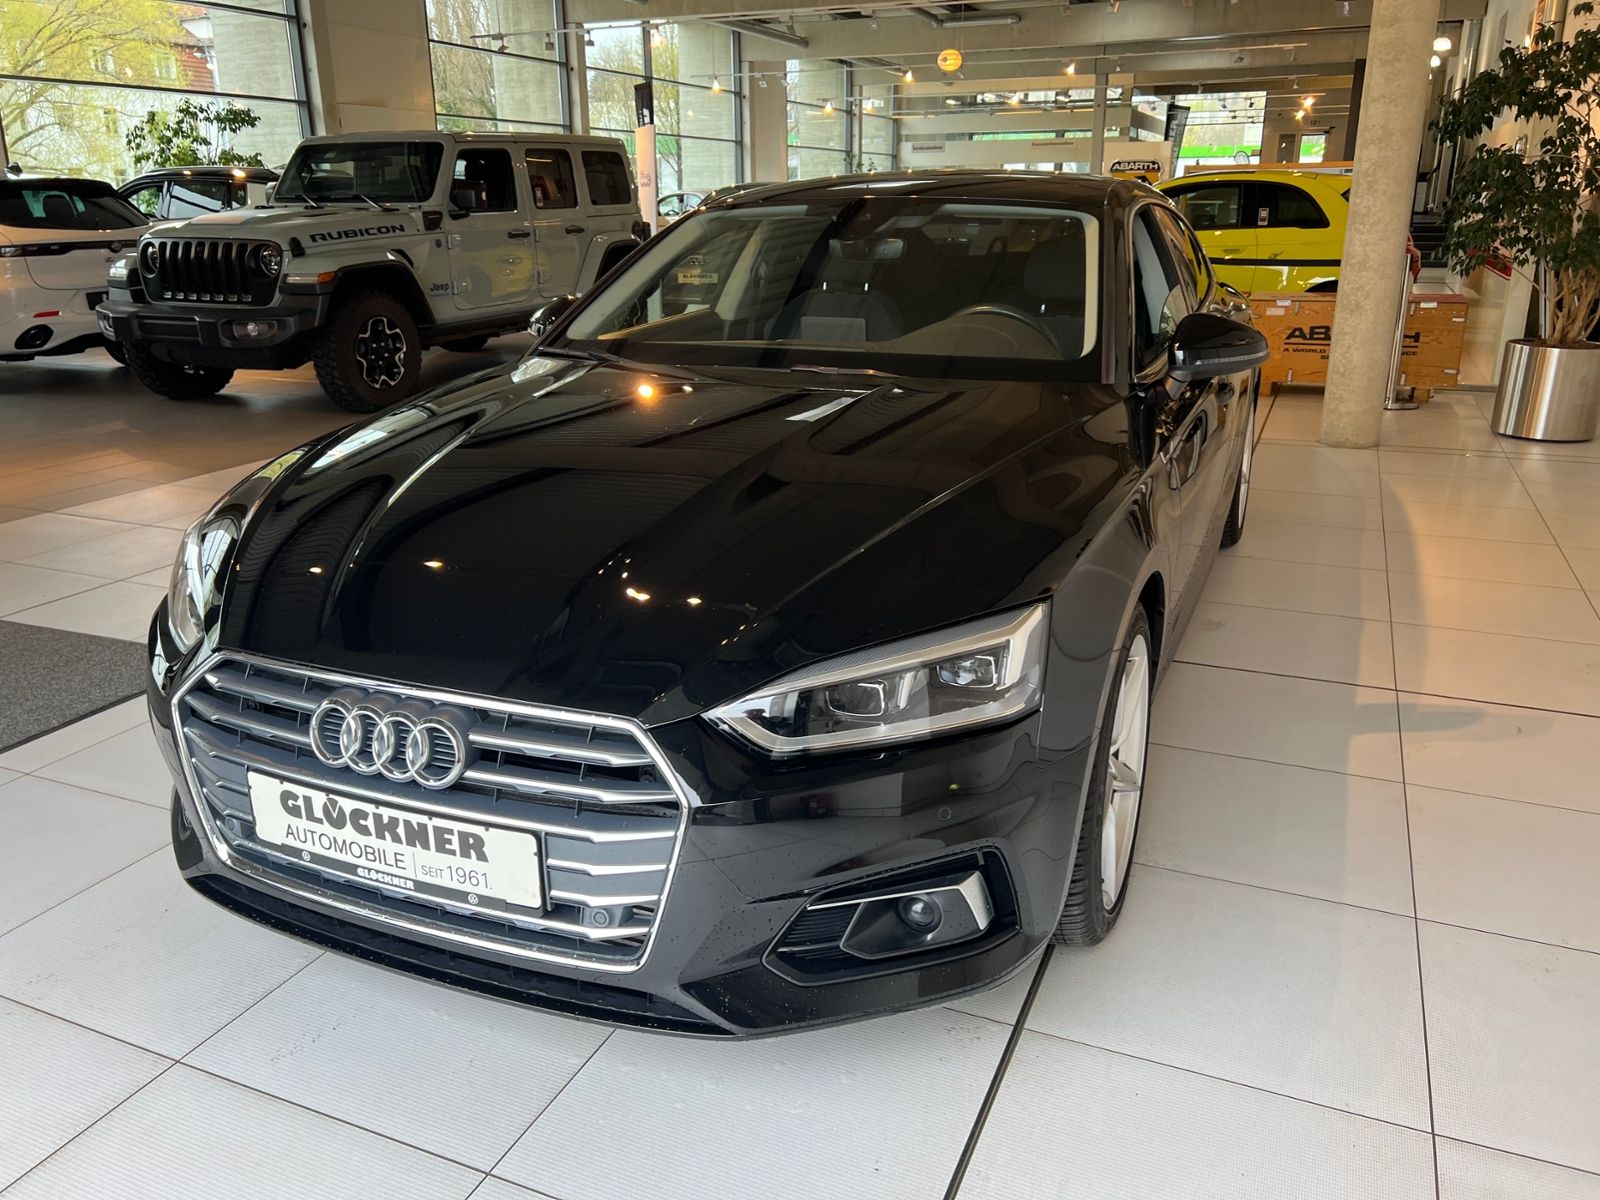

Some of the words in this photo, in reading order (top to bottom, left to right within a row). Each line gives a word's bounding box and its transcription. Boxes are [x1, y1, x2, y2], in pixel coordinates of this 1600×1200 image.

[1112, 162, 1158, 170] ABARTH
[309, 224, 405, 242] RUBICON
[285, 823, 407, 870] AUTOMOBILE
[421, 865, 445, 879] SEIT
